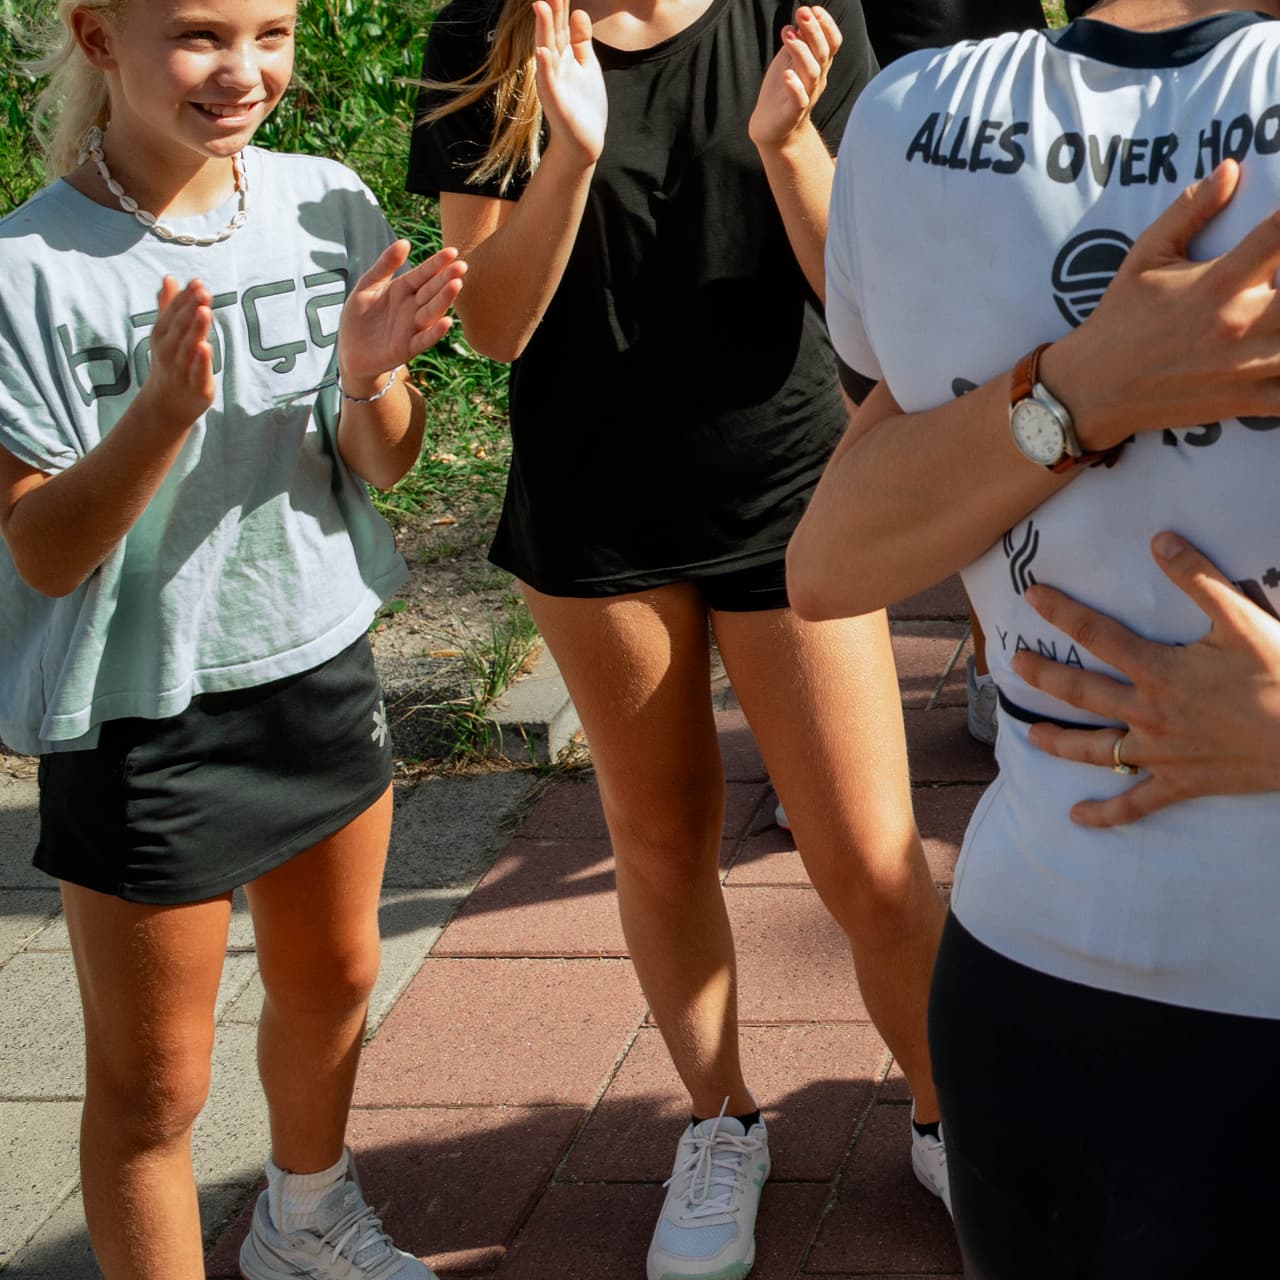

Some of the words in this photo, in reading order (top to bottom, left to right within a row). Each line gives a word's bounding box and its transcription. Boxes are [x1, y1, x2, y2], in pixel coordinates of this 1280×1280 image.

[906, 111, 1030, 176] ALLES
[1046, 132, 1178, 188] OVER
[995, 624, 1085, 670] YANA
